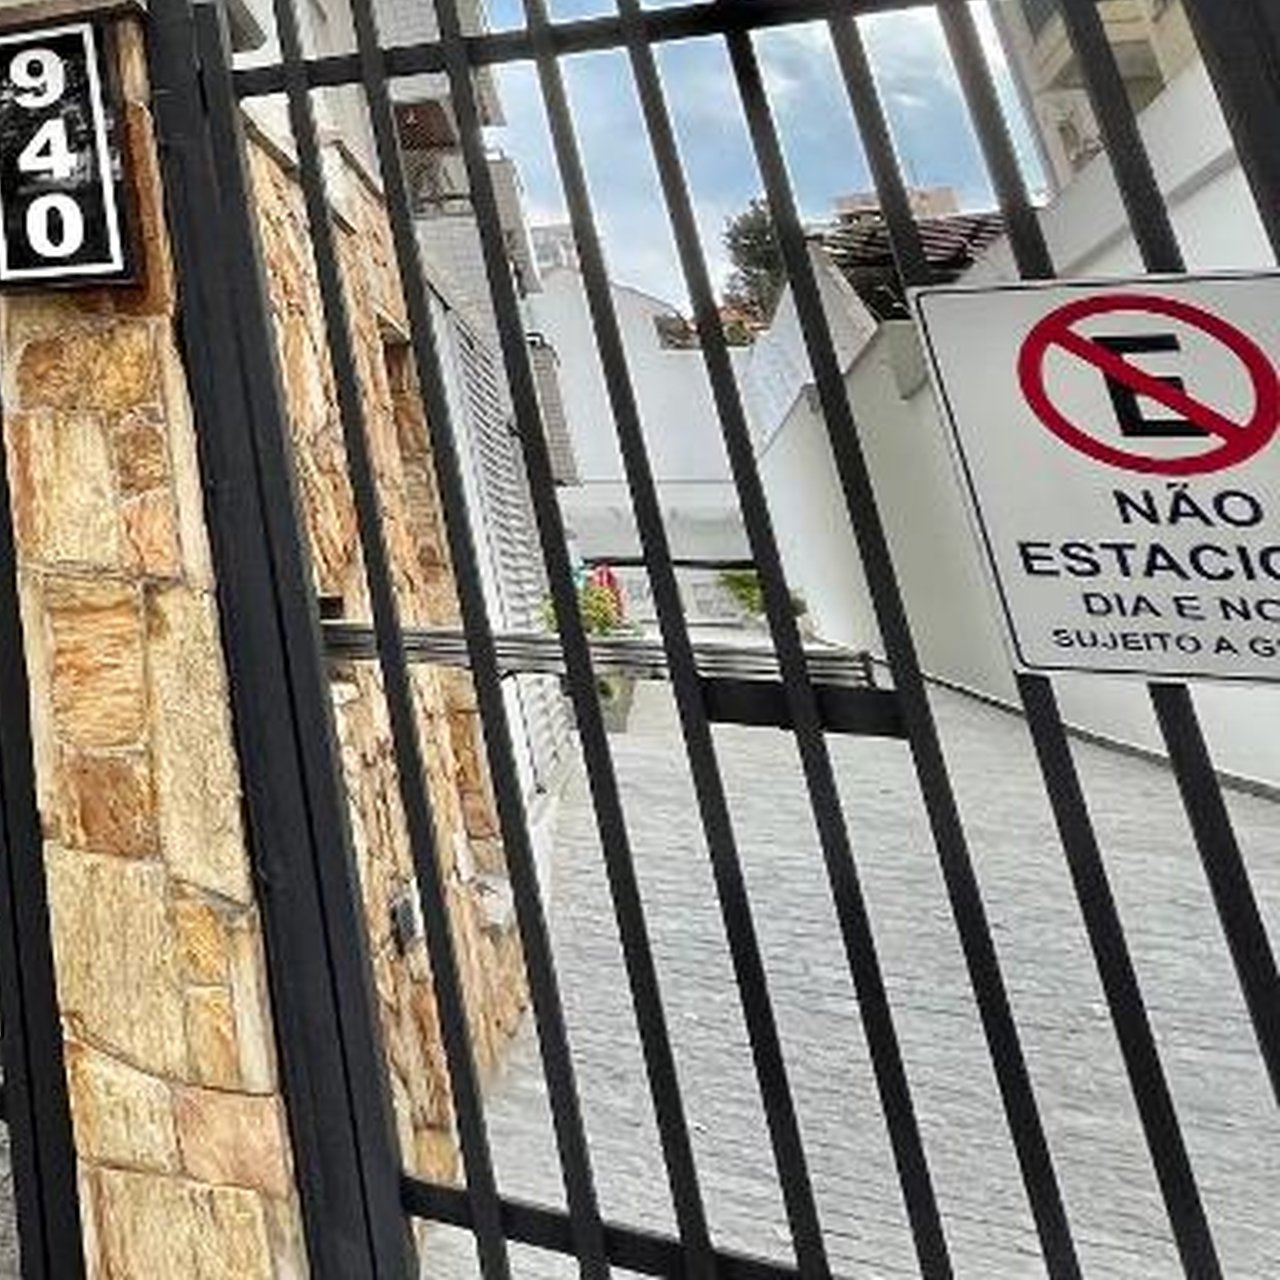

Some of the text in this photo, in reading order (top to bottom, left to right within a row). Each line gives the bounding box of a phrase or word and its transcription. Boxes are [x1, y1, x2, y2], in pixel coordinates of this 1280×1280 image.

[8, 47, 85, 259] 940
[1091, 333, 1210, 437] E
[1112, 483, 1264, 527] NÃO
[1083, 592, 1162, 617] DIA
[1172, 595, 1206, 621] E
[1052, 629, 1280, 658] SUJEITO A G
